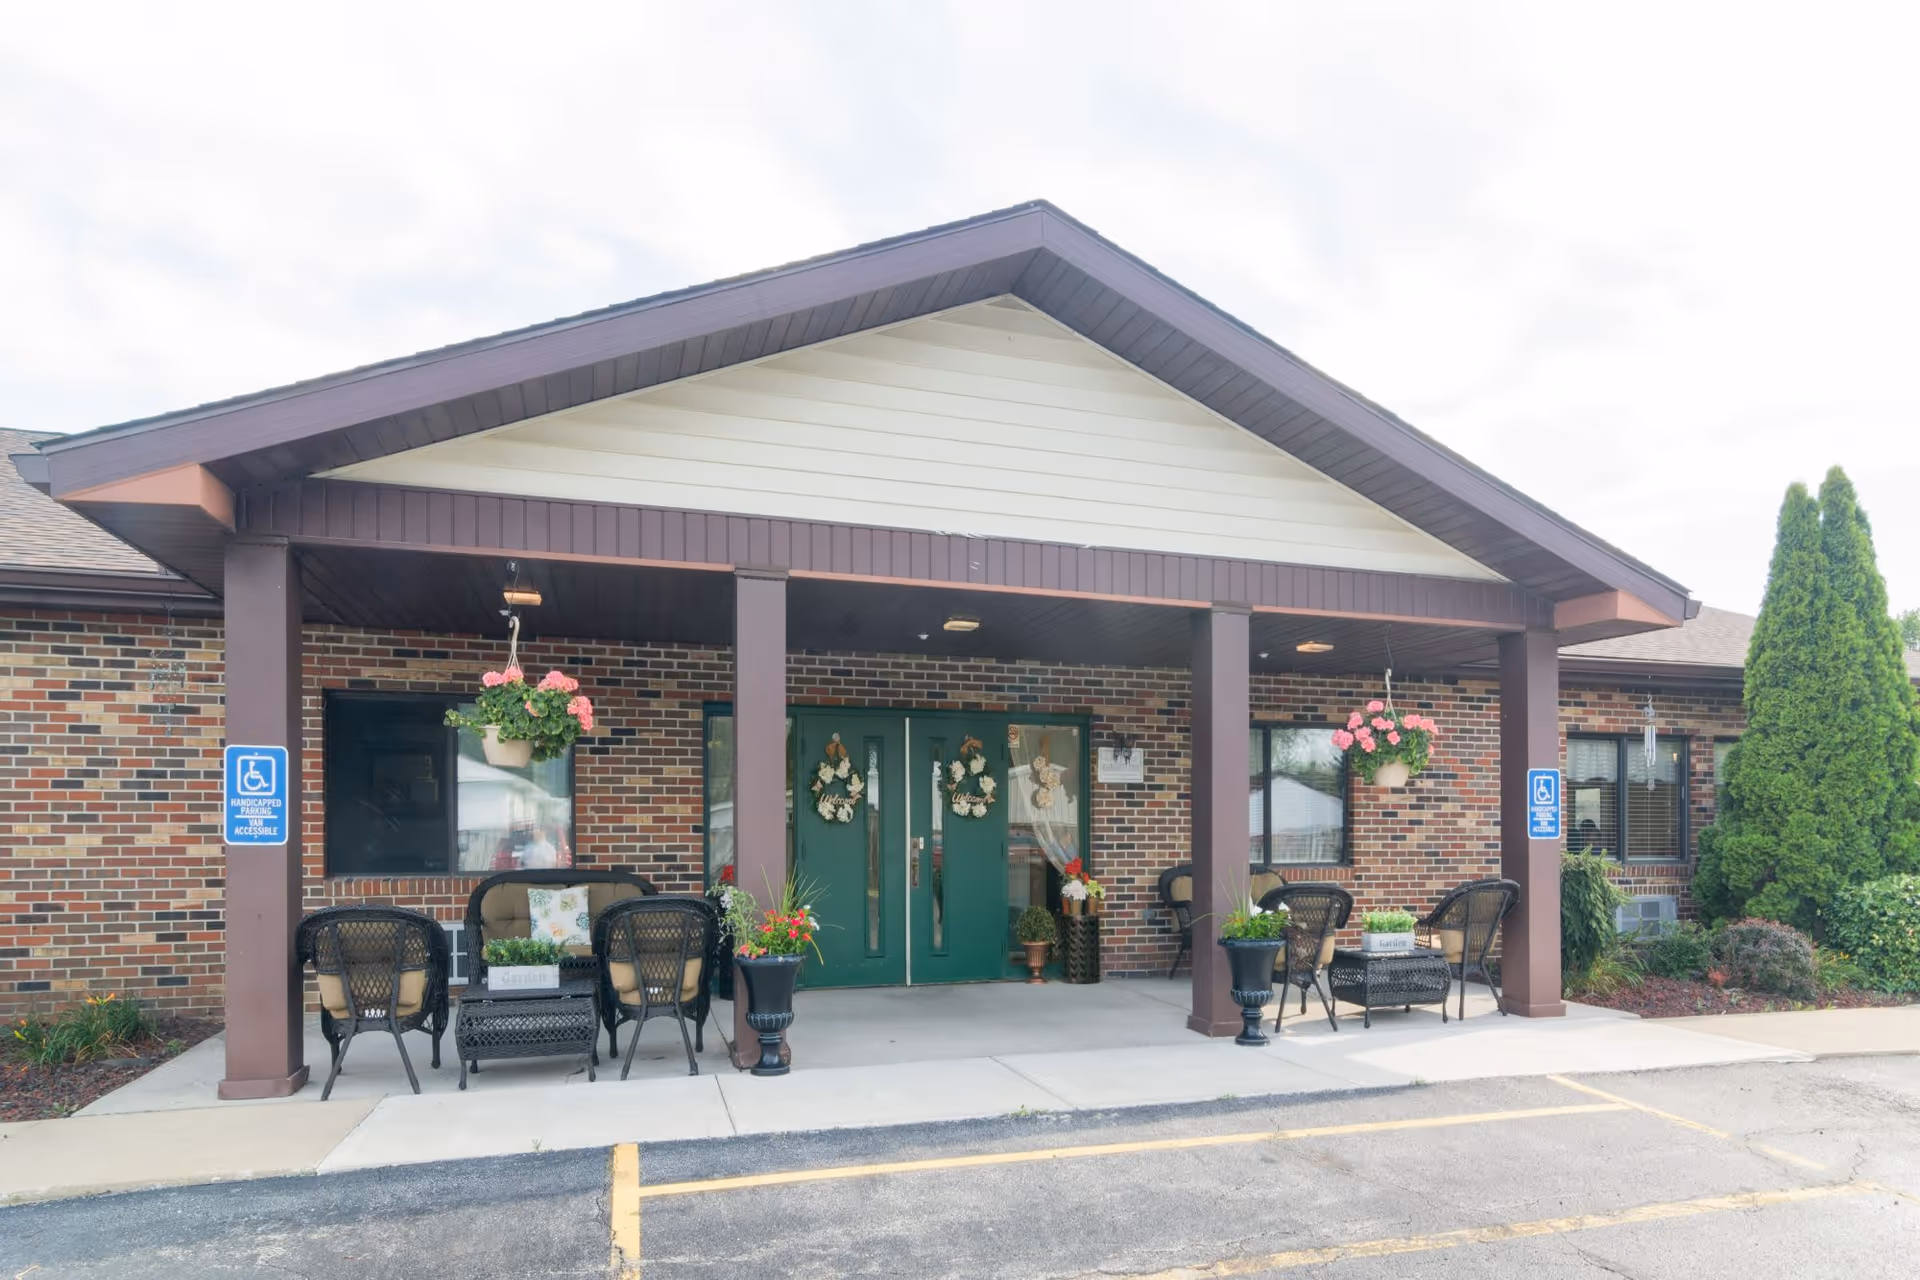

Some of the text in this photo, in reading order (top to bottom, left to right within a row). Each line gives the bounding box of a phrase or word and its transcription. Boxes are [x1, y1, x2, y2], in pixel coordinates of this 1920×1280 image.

[231, 798, 282, 807] HANDICAPPED
[820, 793, 856, 805] Welcome
[240, 806, 272, 815] PARKING
[248, 818, 264, 827] VAN
[234, 826, 279, 836] ACCESSIBLE
